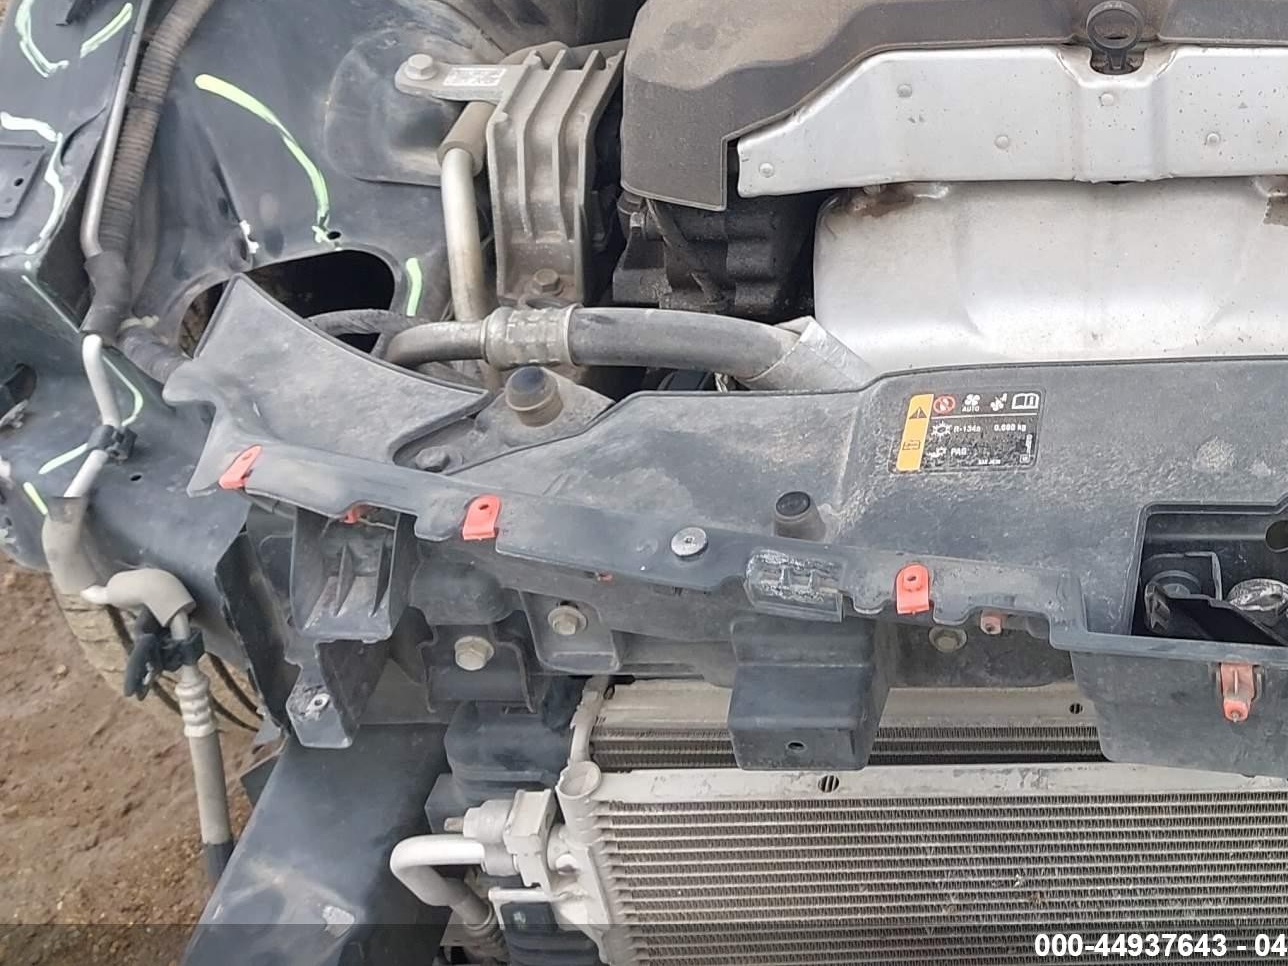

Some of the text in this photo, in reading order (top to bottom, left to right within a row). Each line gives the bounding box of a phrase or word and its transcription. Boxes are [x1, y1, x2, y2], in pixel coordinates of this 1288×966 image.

[962, 405, 980, 413] AUTO
[953, 424, 981, 433] R-134a
[1017, 423, 1027, 432] kg
[950, 447, 967, 456] PAG
